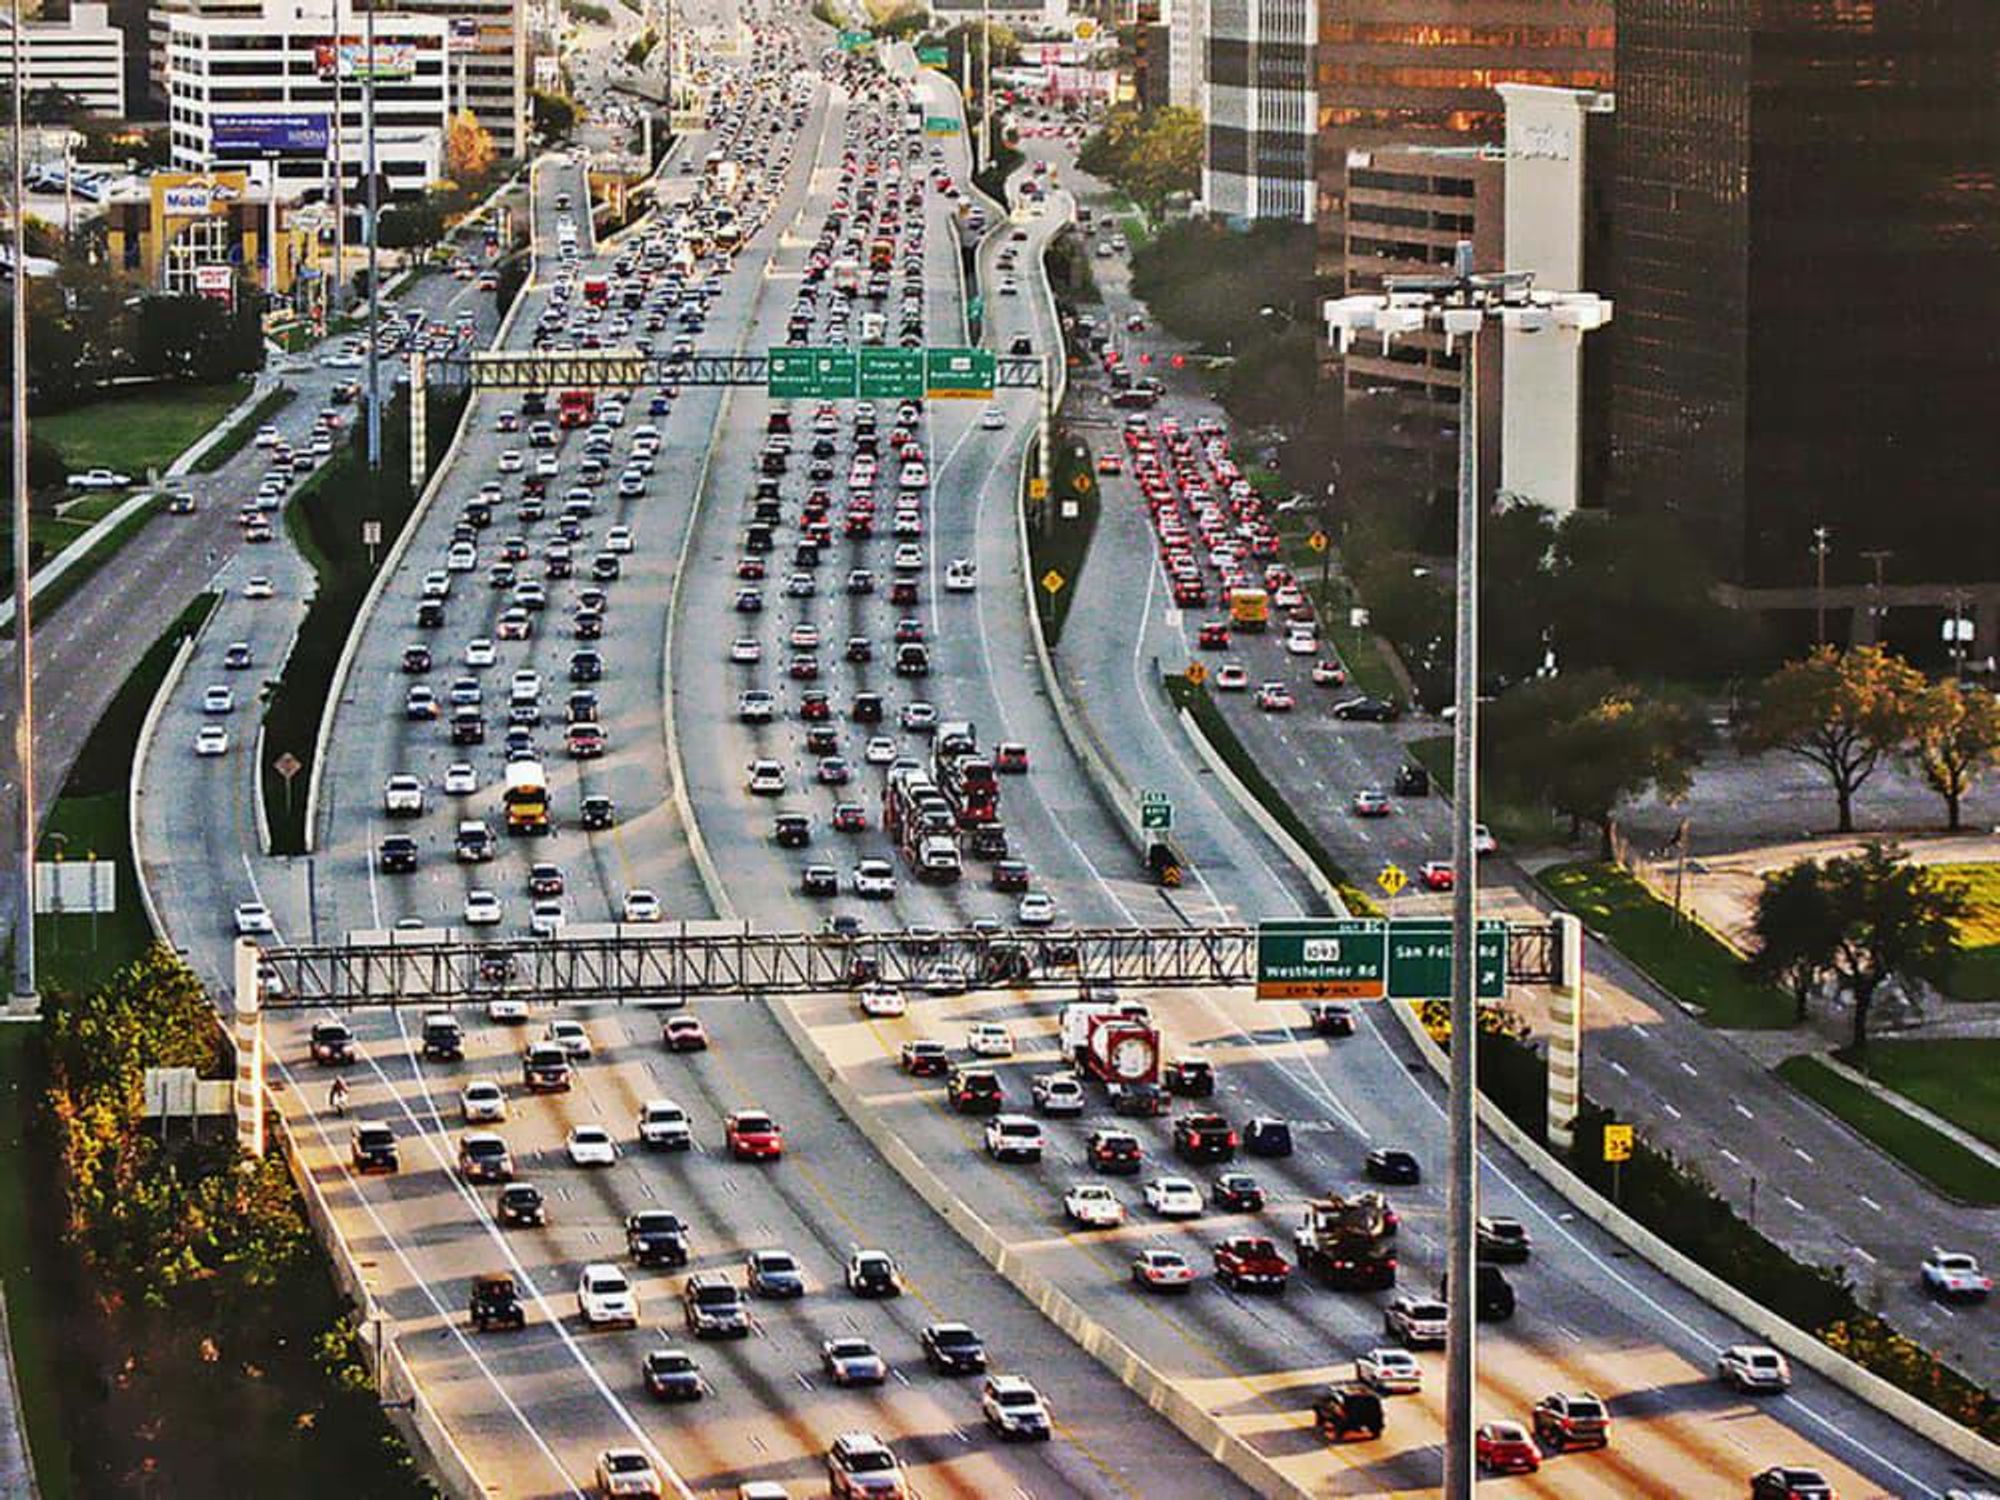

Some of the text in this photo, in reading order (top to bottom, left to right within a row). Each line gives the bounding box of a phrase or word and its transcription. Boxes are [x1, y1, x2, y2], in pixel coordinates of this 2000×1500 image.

[167, 194, 207, 207] Mobil
[1307, 945, 1337, 959] 1093
[1395, 944, 1422, 958] San
[1479, 944, 1498, 958] Rd
[1266, 964, 1377, 977] Westheimer Rd
